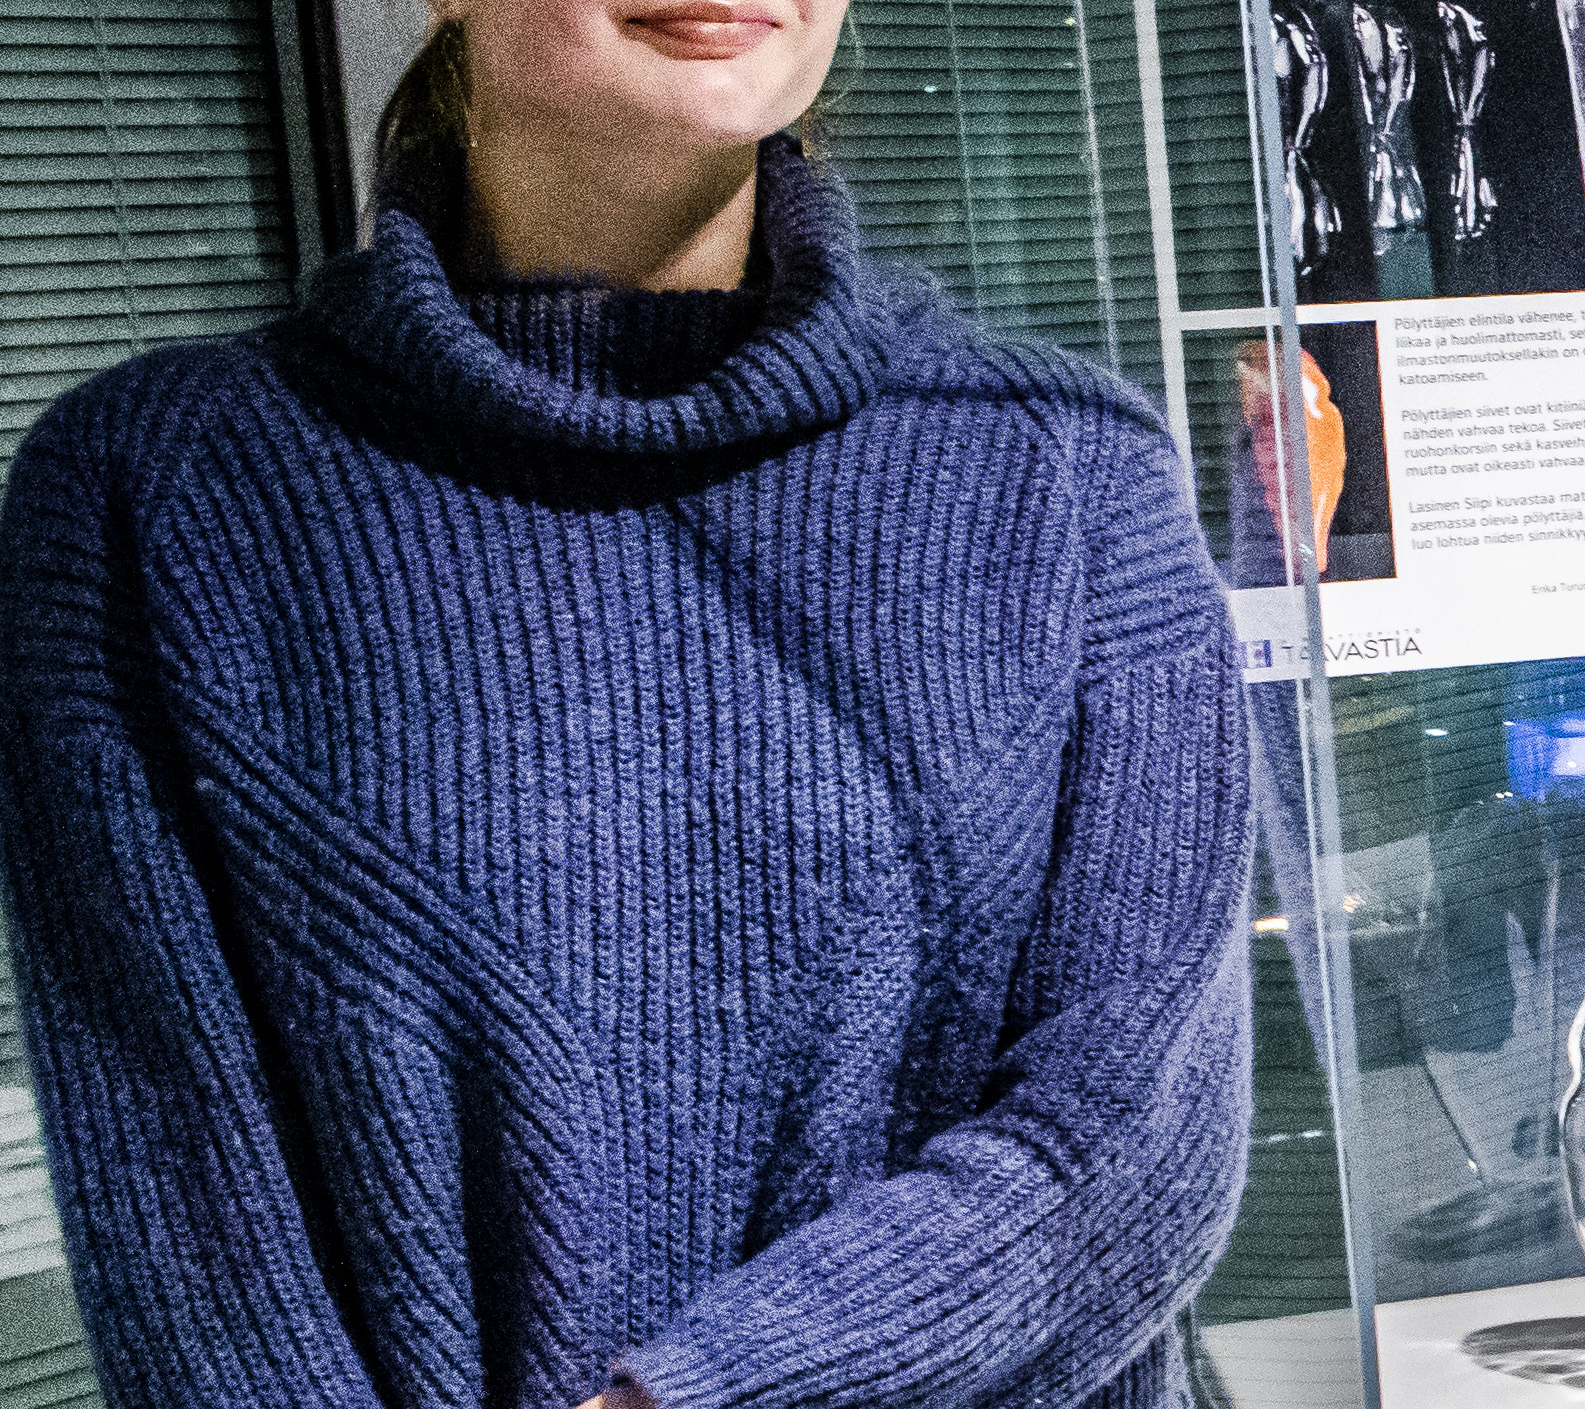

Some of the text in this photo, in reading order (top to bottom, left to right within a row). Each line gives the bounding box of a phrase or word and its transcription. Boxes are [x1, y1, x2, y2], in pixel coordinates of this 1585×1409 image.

[1393, 314, 1466, 333] Pölyttäjien
[1468, 311, 1515, 326] elintila
[1394, 334, 1432, 349] liikaa
[1434, 333, 1448, 350] ja
[1396, 346, 1560, 367] ilmastonmuutoksellakin
[1562, 348, 1580, 358] on
[1400, 406, 1473, 425] Pölyttäjien
[1475, 403, 1511, 418] siivet
[1513, 401, 1543, 415] ovat
[1402, 425, 1454, 440] nähden
[1457, 423, 1506, 437] vahvaa
[1404, 440, 1498, 459] ruohonkorsiin
[1501, 438, 1533, 453] sekä
[1405, 462, 1448, 477] mutta
[1450, 459, 1480, 474] ovat
[1483, 456, 1536, 472] oikeasti
[1538, 454, 1585, 468] vahvaa
[1407, 499, 1461, 513] Lasinen
[1463, 495, 1493, 512] Siipi
[1495, 492, 1556, 507] kuvastaa
[1410, 518, 1477, 532] asemassa
[1479, 512, 1519, 527] olevia
[1410, 537, 1434, 550] luo
[1435, 533, 1481, 548] lohtua
[1483, 530, 1525, 545] niiden
